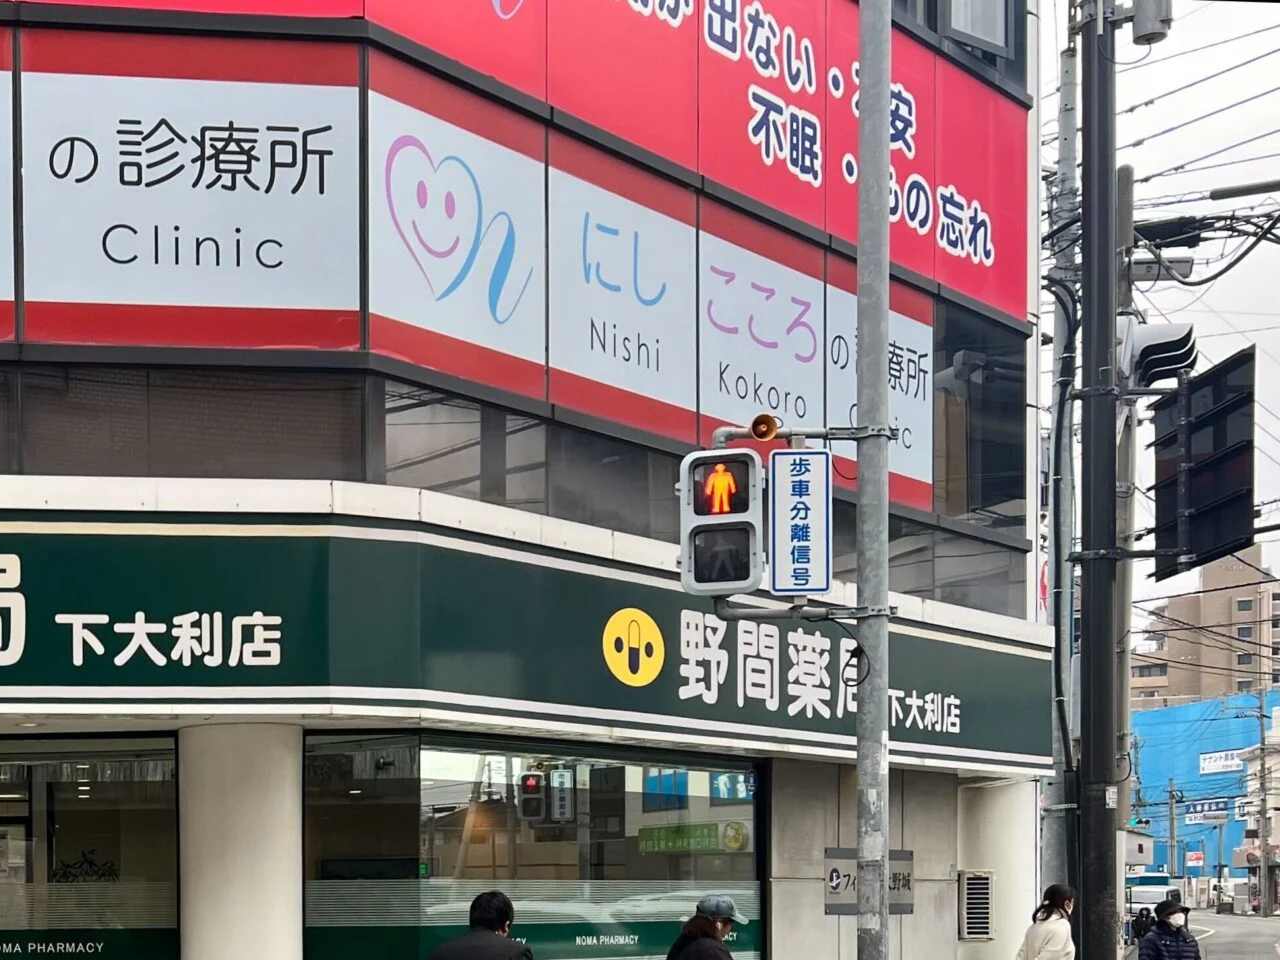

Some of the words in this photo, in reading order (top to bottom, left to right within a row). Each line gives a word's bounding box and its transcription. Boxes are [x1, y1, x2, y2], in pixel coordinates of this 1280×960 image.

[49, 117, 333, 195] の診療所
[101, 223, 284, 269] Clinic
[583, 212, 666, 306] にし
[707, 265, 817, 363] こころ
[830, 328, 928, 401] の療所
[591, 317, 660, 372] Nishi
[719, 361, 807, 418] Kokoro
[790, 457, 811, 586] 歩車分離信号
[55, 611, 282, 667] 下大利店
[888, 688, 960, 734] 下大利店
[27, 942, 104, 953] PHARMACY
[575, 935, 598, 946] NOMA
[599, 934, 639, 945] PHARMACY
